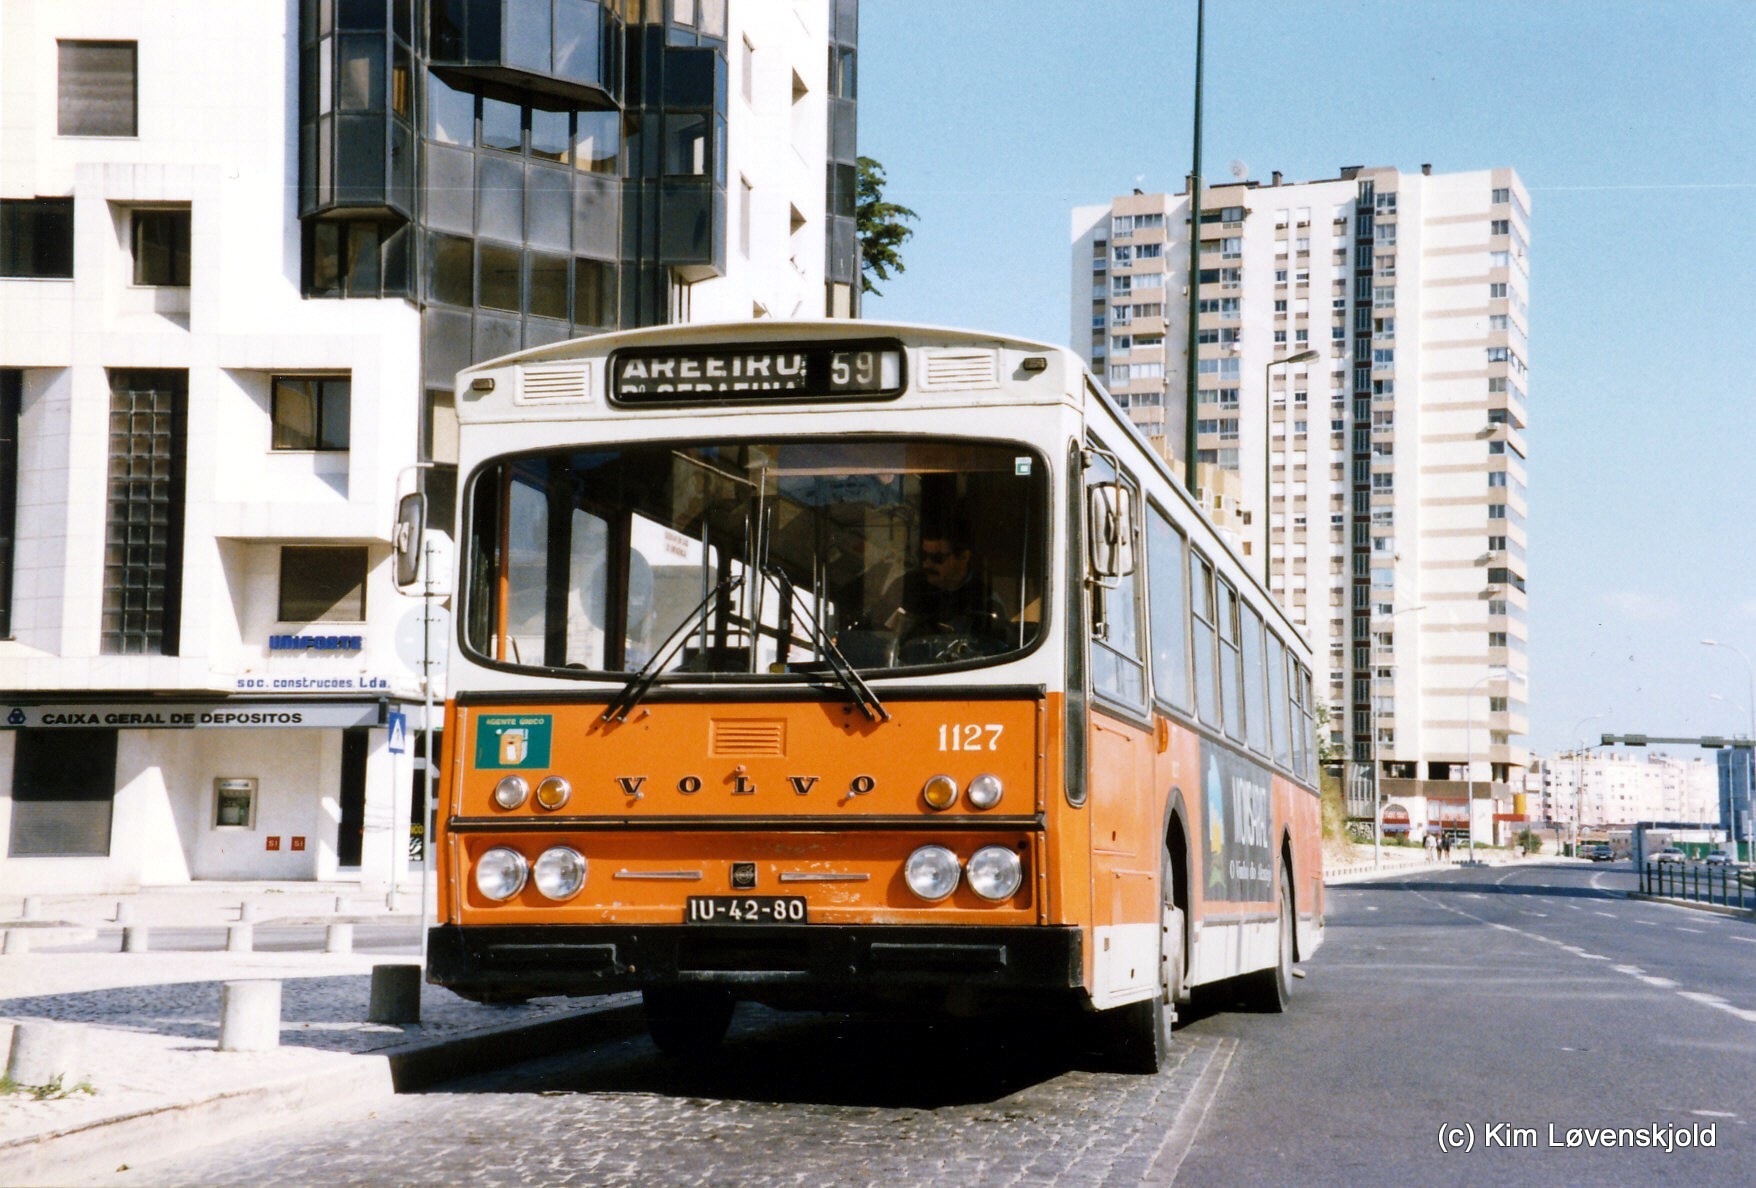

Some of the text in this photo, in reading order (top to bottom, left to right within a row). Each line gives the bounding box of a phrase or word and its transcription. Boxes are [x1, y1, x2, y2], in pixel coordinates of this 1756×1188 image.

[621, 354, 801, 379] AREEIRO
[831, 352, 874, 385] 59
[42, 713, 99, 724] CAIXA
[104, 713, 165, 724] GERAL
[170, 713, 195, 724] DE
[938, 723, 1004, 751] 1127
[615, 776, 876, 796] VOLVO
[691, 899, 804, 920] IU-42-80
